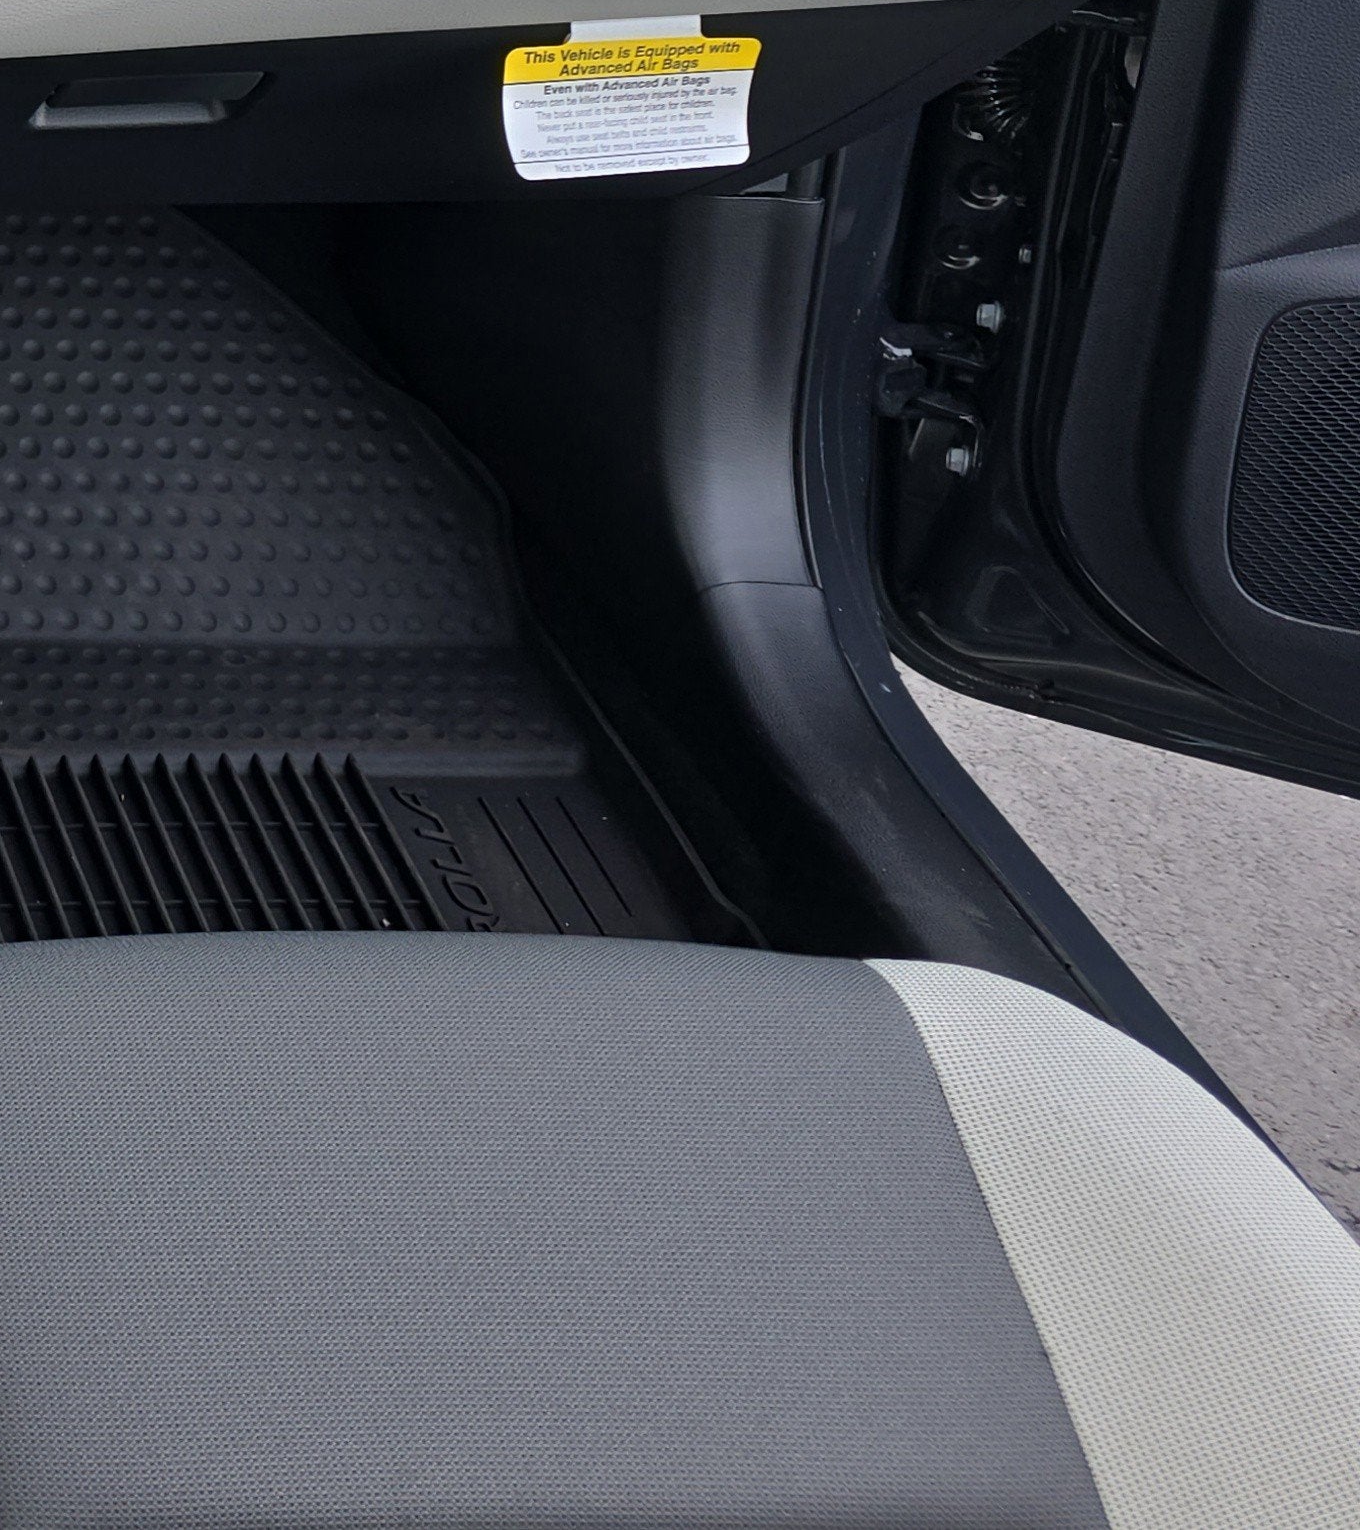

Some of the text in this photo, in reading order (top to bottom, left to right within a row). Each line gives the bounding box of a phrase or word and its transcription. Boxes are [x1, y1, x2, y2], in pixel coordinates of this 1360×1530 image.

[524, 43, 740, 64] This Vehicle is Equipped with
[560, 58, 698, 77] Advanced Air Bags
[544, 76, 710, 95] Even with Advanced Air Bags
[514, 99, 547, 110] Children
[550, 98, 564, 106] can
[567, 97, 577, 105] be
[580, 94, 600, 104] killed
[613, 92, 649, 104] seriously
[651, 90, 678, 101] injured
[681, 90, 690, 100] by
[693, 87, 705, 97] the
[708, 87, 718, 95] air
[537, 110, 551, 119] The
[553, 108, 573, 118] back
[576, 108, 591, 117] seat
[603, 106, 616, 115] the
[619, 104, 642, 114] safest
[644, 104, 665, 114] place
[668, 101, 679, 111] for
[537, 122, 560, 132] Never
[563, 122, 577, 131] put
[630, 117, 648, 126] child
[651, 115, 666, 124] seat
[670, 115, 676, 123] in
[679, 113, 692, 122] the
[593, 132, 609, 141] seat
[611, 130, 630, 140] belts
[633, 129, 648, 138] and
[650, 127, 668, 137] child
[521, 149, 535, 158] See
[571, 144, 598, 155] manual
[601, 143, 610, 152] for
[613, 142, 634, 151] more
[636, 138, 679, 150] information
[682, 136, 703, 146] about
[705, 136, 715, 144] air
[555, 163, 570, 172] Not
[572, 163, 580, 171] to
[583, 161, 595, 170] be
[598, 158, 635, 168] removed
[638, 156, 666, 167] except
[669, 154, 678, 165] by
